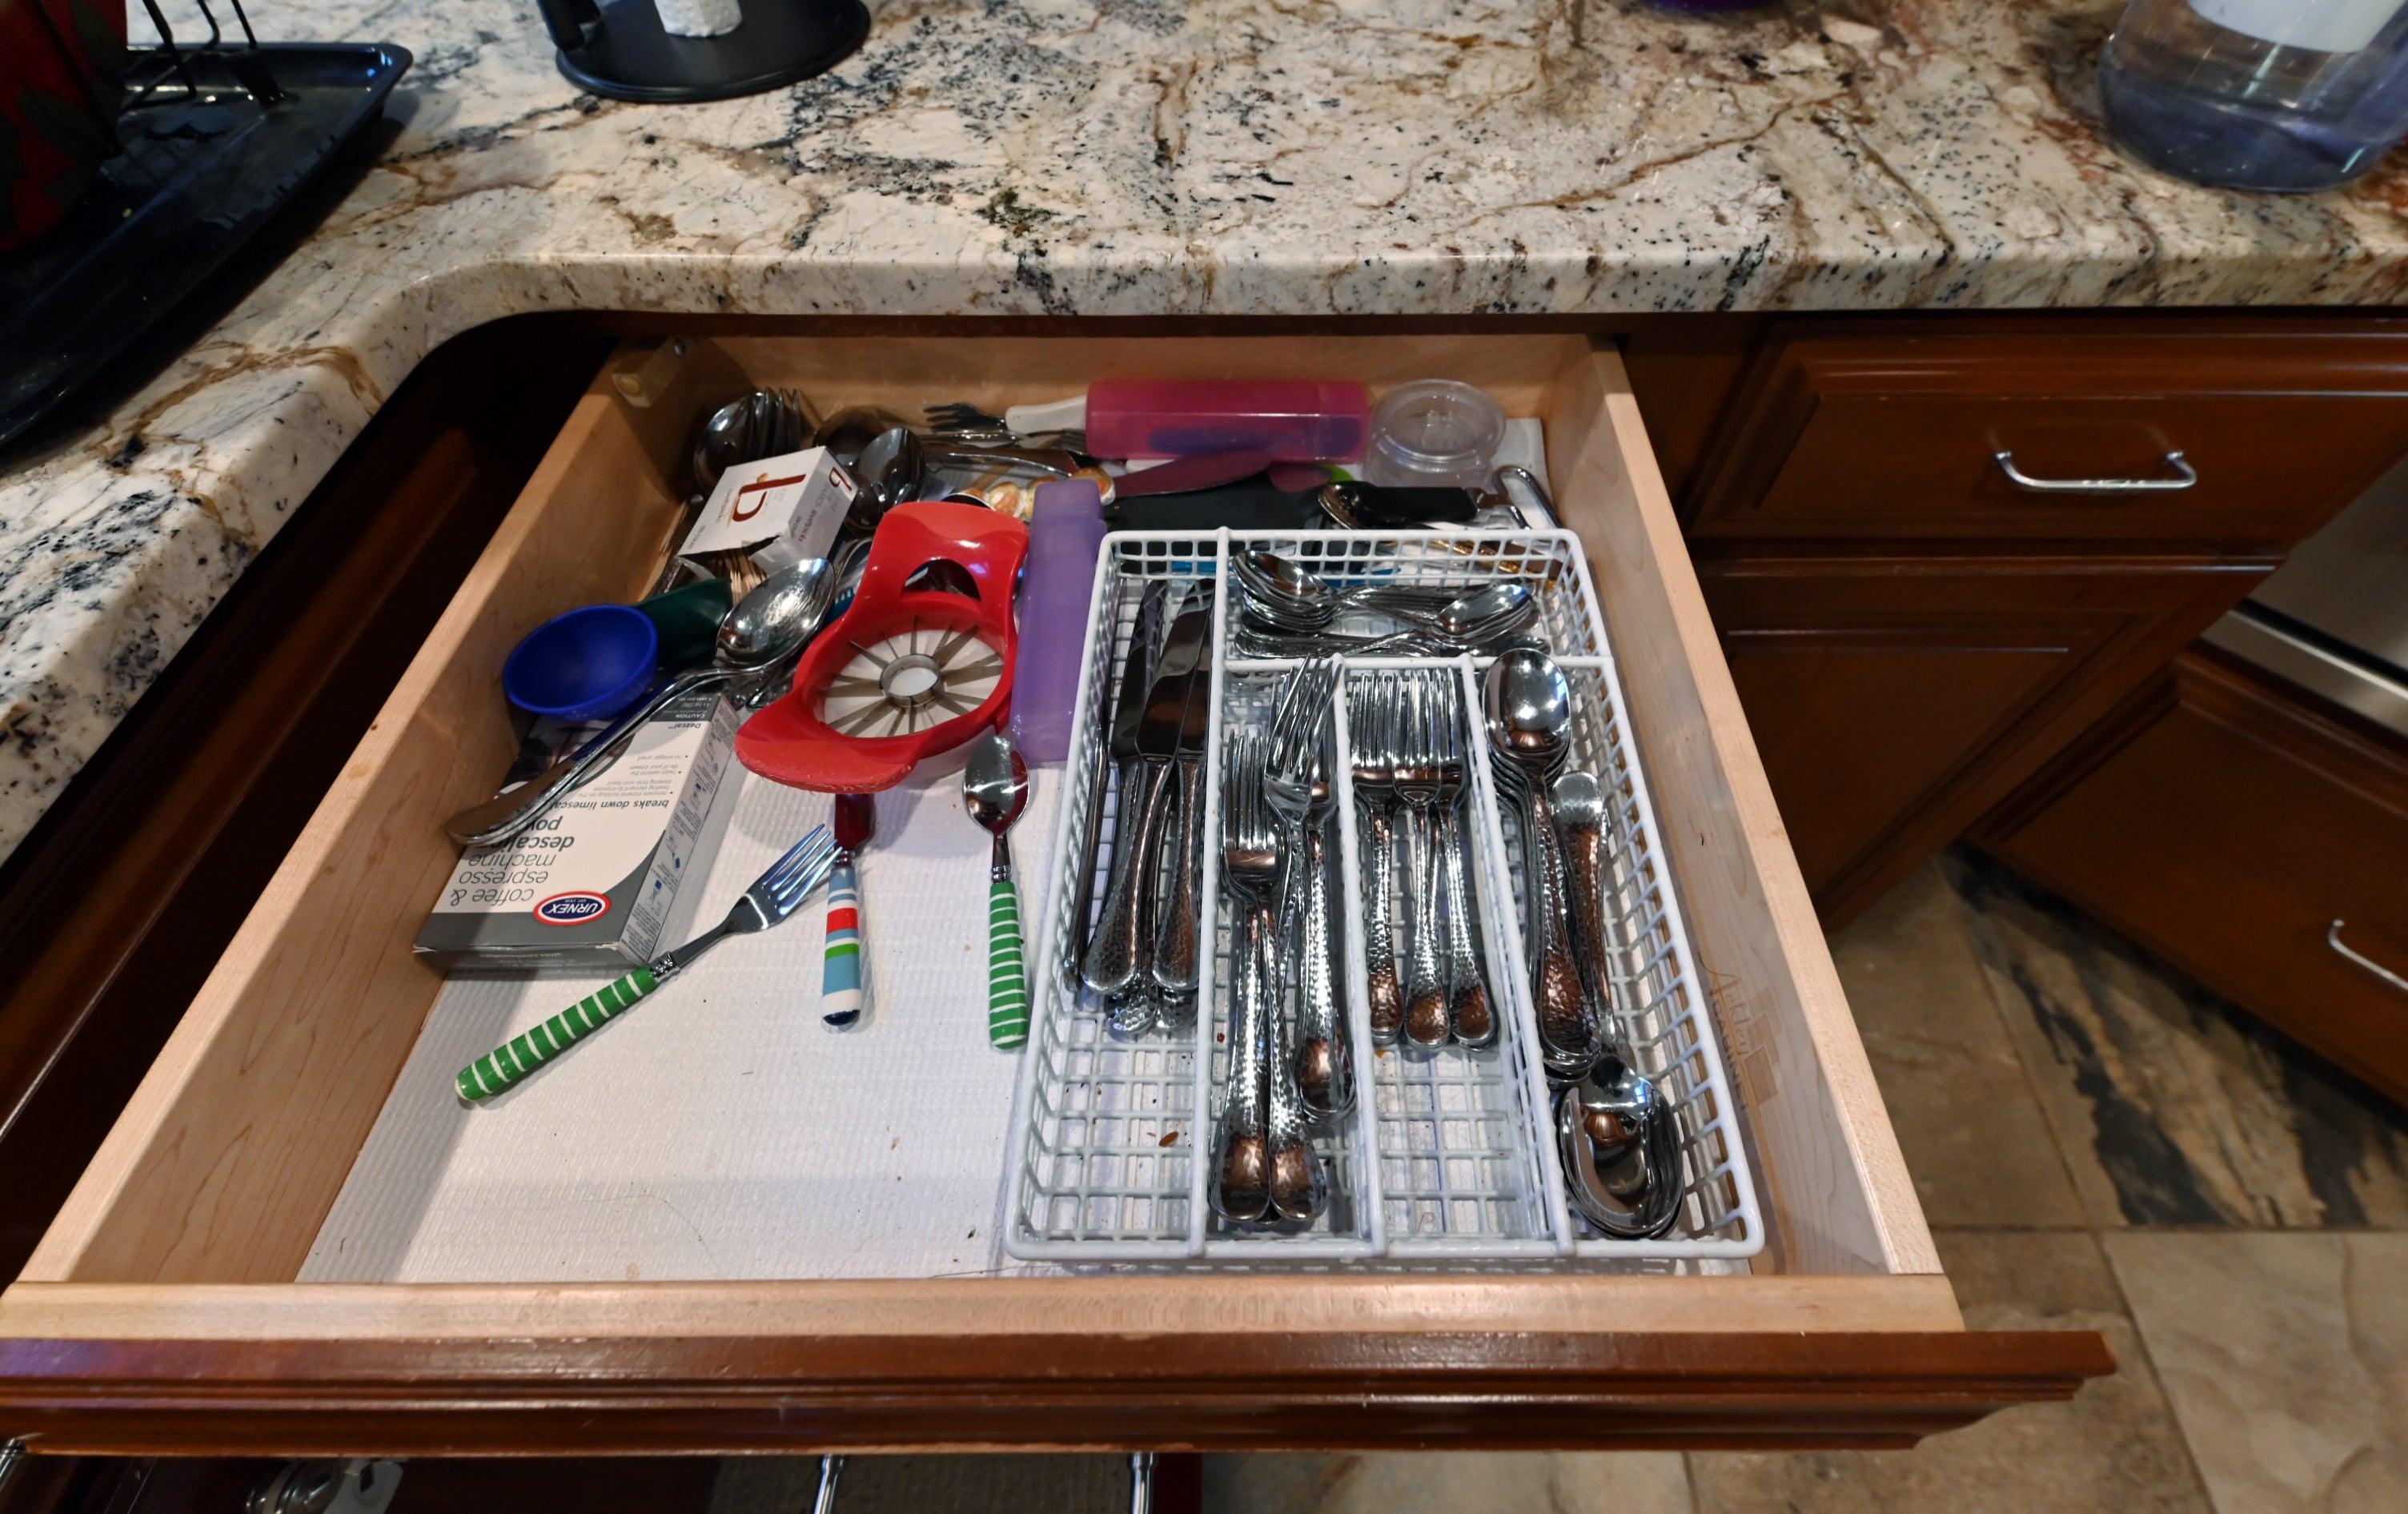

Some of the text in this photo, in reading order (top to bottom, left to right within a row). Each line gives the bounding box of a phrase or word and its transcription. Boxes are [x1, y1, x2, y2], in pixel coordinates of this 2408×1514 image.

[600, 800, 629, 809] down
[633, 800, 669, 809] breaks
[468, 853, 556, 870] machine
[459, 868, 548, 885] espresso
[451, 889, 534, 906] coffee &
[548, 902, 598, 914] URNEX
